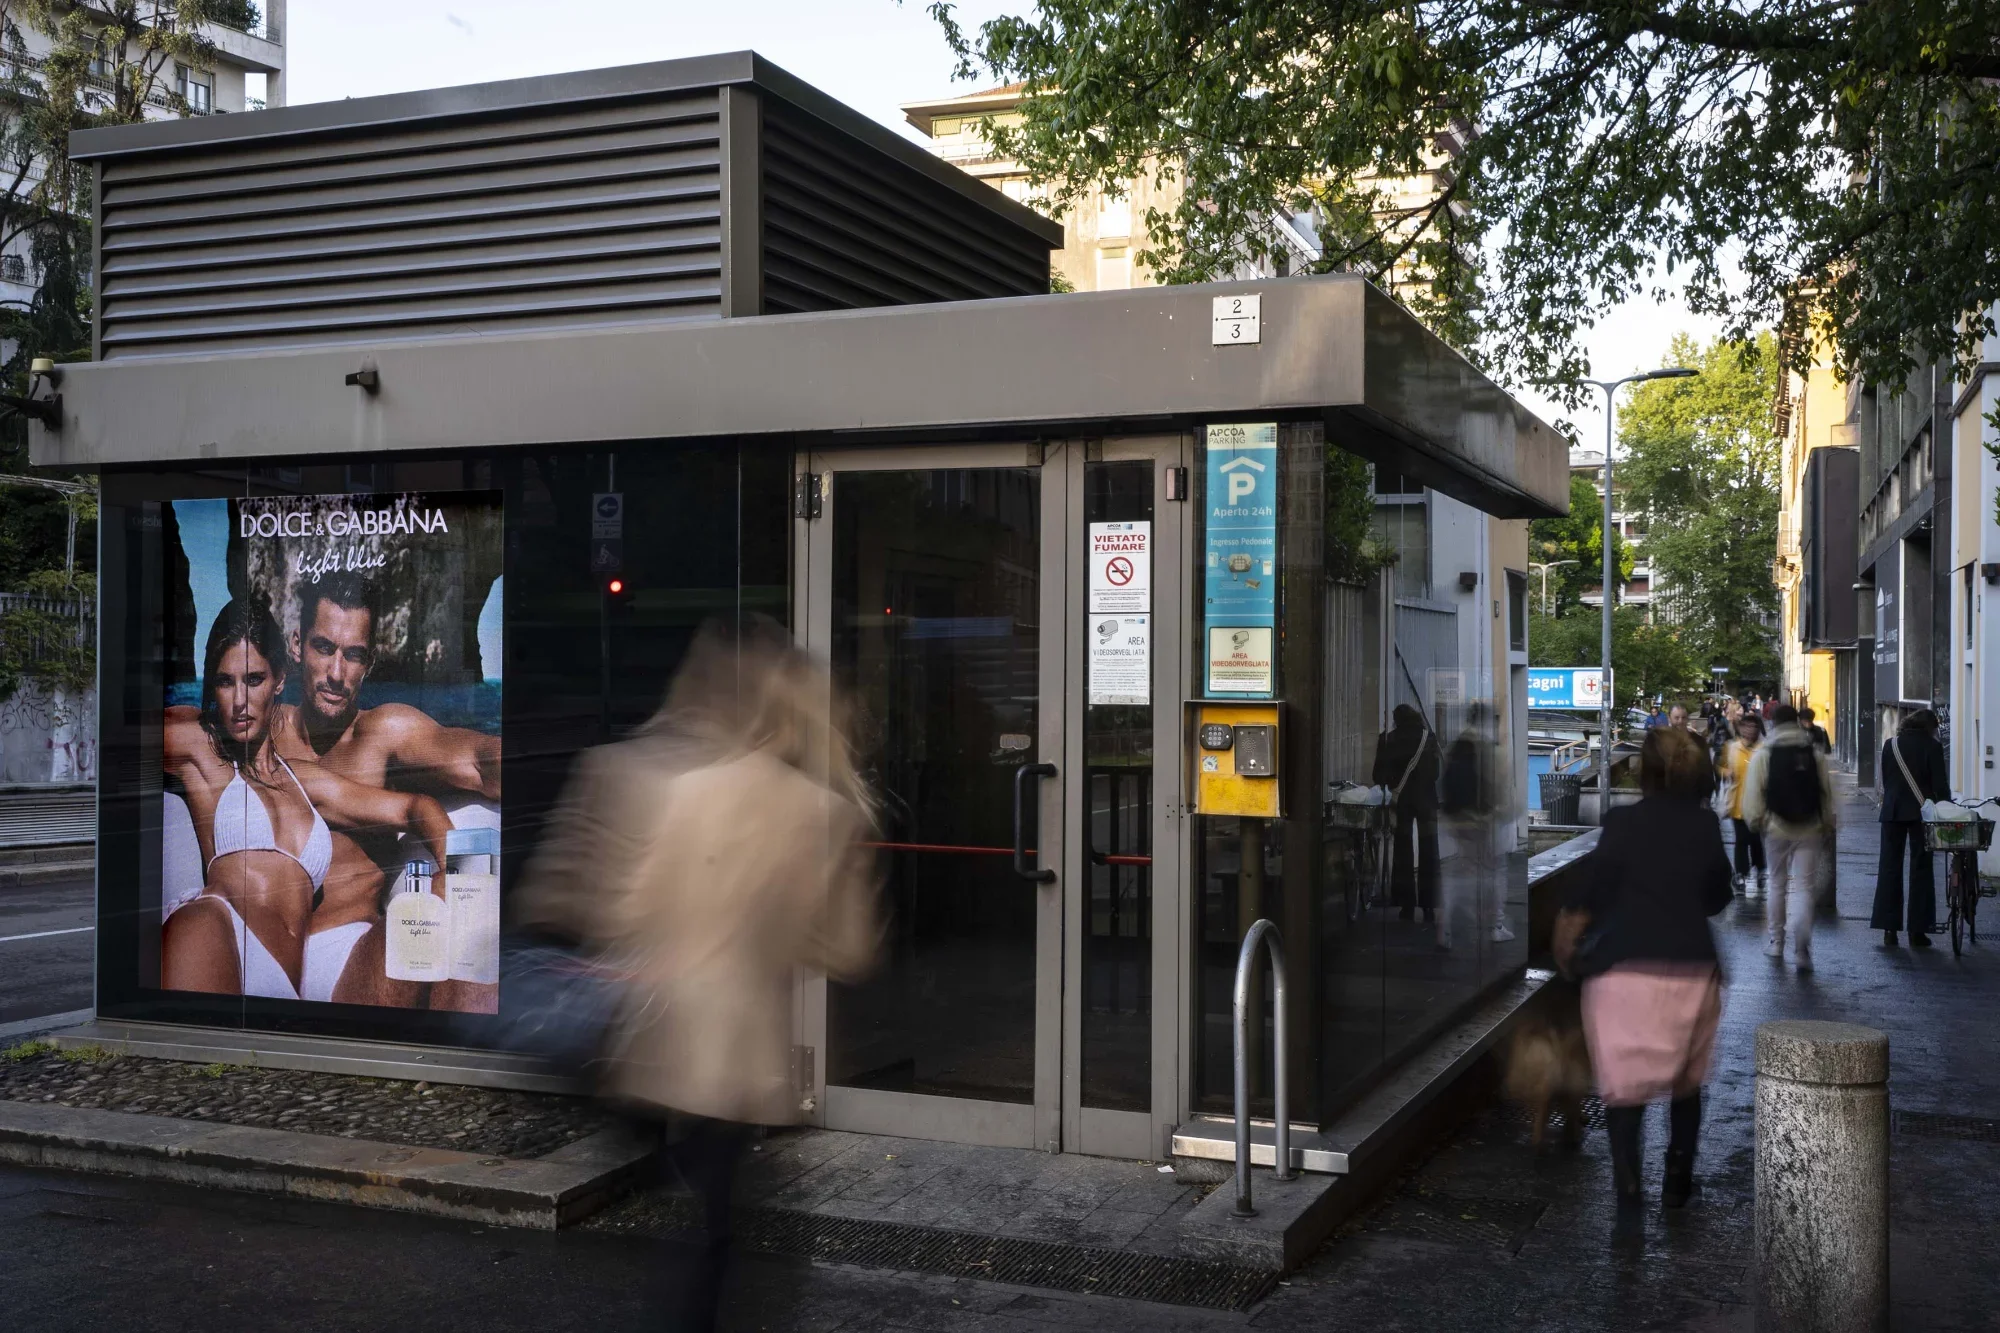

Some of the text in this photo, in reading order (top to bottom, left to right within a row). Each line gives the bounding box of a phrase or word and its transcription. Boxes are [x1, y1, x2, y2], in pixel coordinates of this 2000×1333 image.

[1233, 299, 1242, 314] 2
[1231, 324, 1241, 339] 3
[1209, 428, 1245, 437] APCOA
[1208, 437, 1246, 445] PARKING
[1228, 472, 1256, 506] P
[1213, 505, 1272, 519] Aperto 24h
[240, 511, 313, 538] DOLCE
[326, 508, 449, 537] GABBANA
[1094, 534, 1146, 542] VIETATO
[1210, 537, 1273, 547] Ingresso Pedonale
[1094, 543, 1145, 552] FUMARE
[295, 544, 387, 584] light blue
[1127, 636, 1146, 646] AREA
[1092, 648, 1145, 656] VIDEOSORVEGLIATA
[1211, 660, 1270, 668] VIDEOSORVEGLIATA
